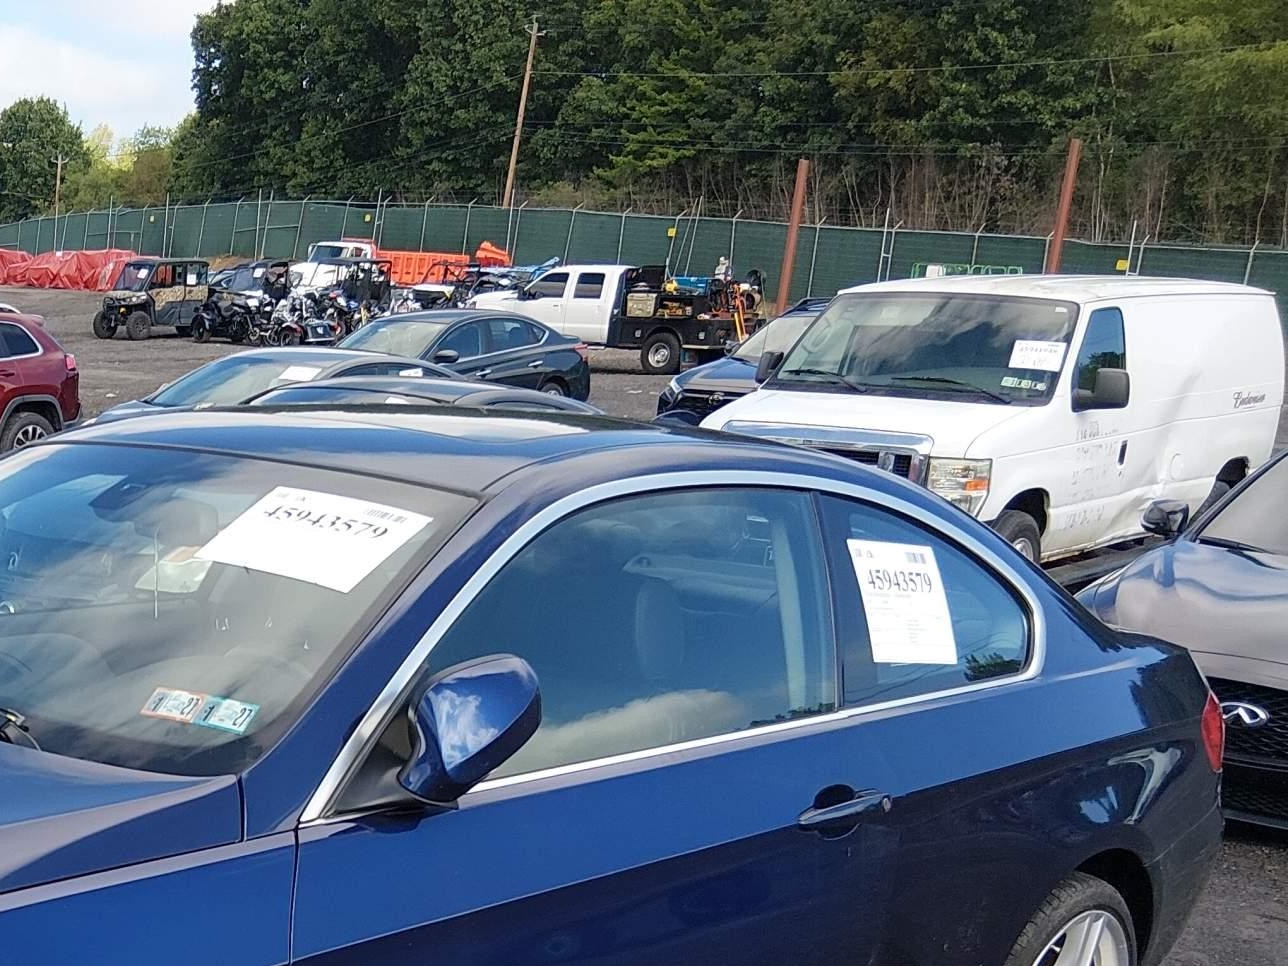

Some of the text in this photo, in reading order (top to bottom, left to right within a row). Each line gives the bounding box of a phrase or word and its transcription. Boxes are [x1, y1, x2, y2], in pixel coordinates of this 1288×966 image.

[264, 505, 389, 538] 45943579
[868, 568, 932, 593] 45943579
[180, 697, 201, 718] 27
[232, 707, 253, 728] 27
